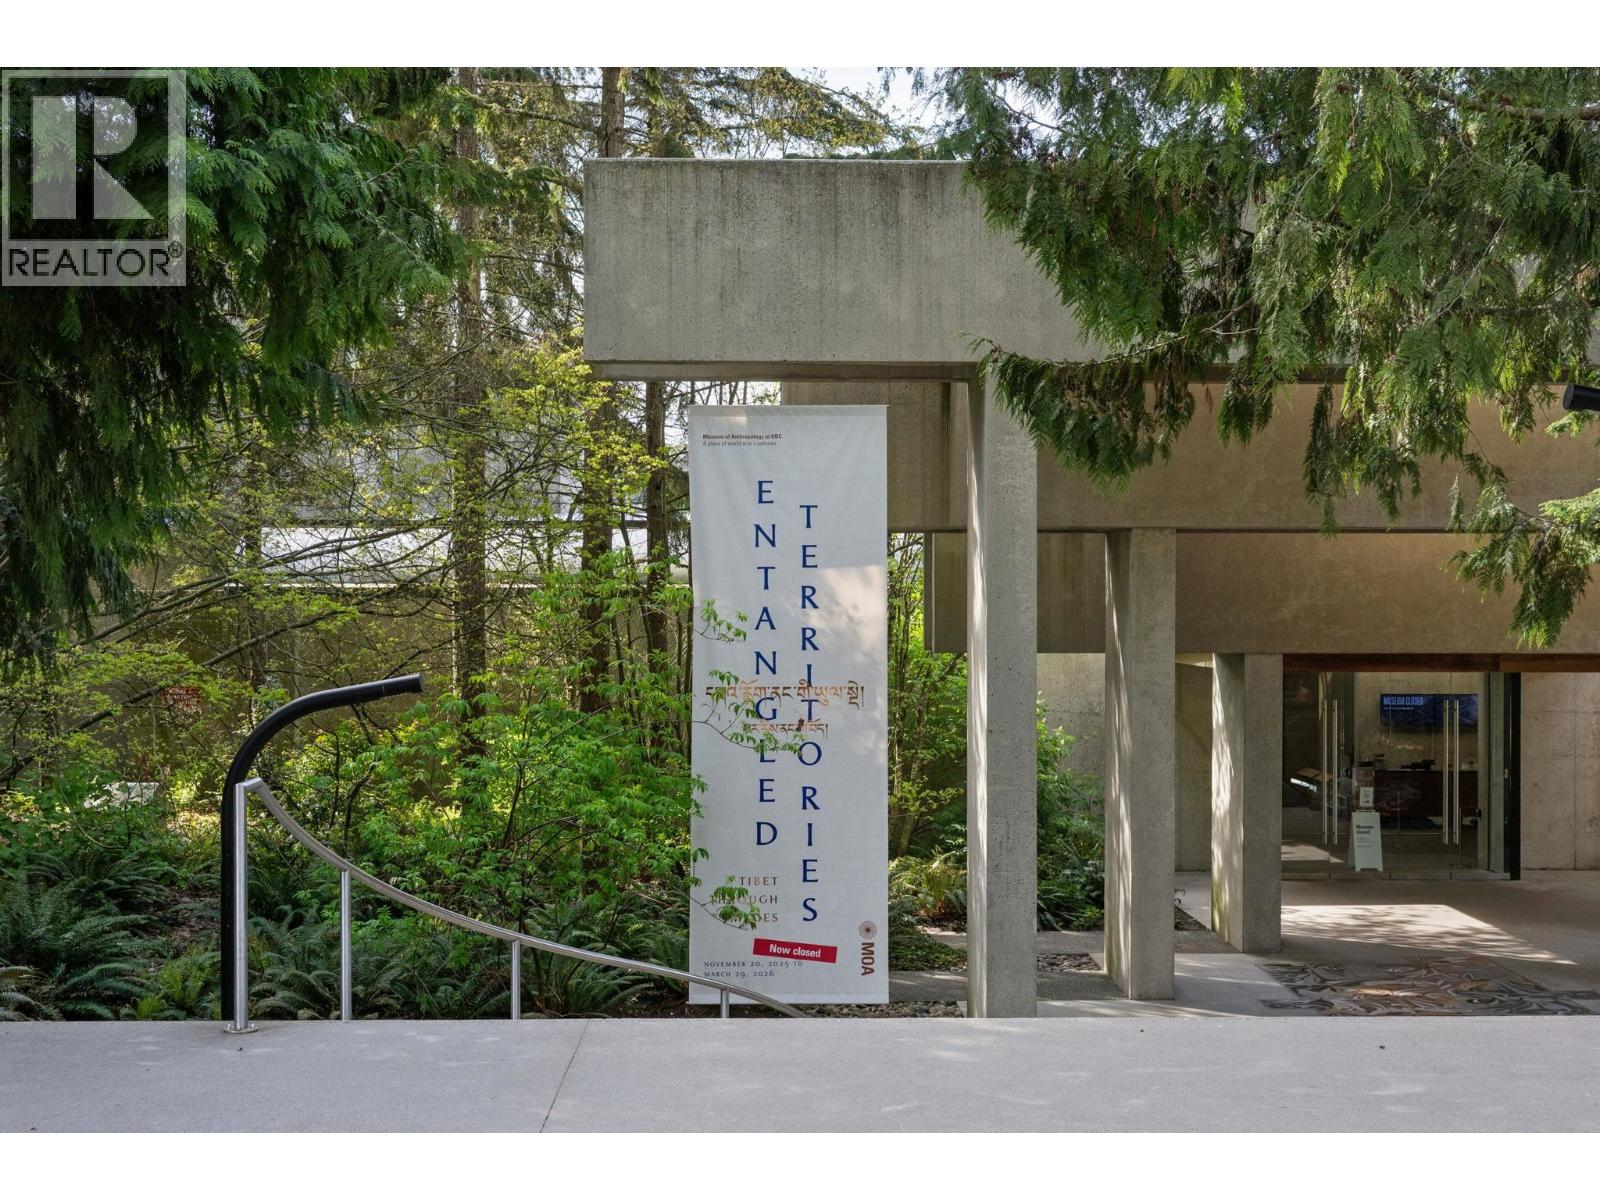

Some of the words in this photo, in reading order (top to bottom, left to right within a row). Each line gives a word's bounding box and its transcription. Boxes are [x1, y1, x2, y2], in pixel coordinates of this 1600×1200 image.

[731, 433, 764, 441] Anthropology
[755, 480, 778, 846] ENTANGLED
[797, 504, 823, 922] TERRITORIES
[739, 876, 779, 886] TIBET
[769, 943, 791, 955] Now
[792, 947, 821, 958] closed
[861, 942, 875, 976] MOA
[753, 969, 775, 977] 2026
